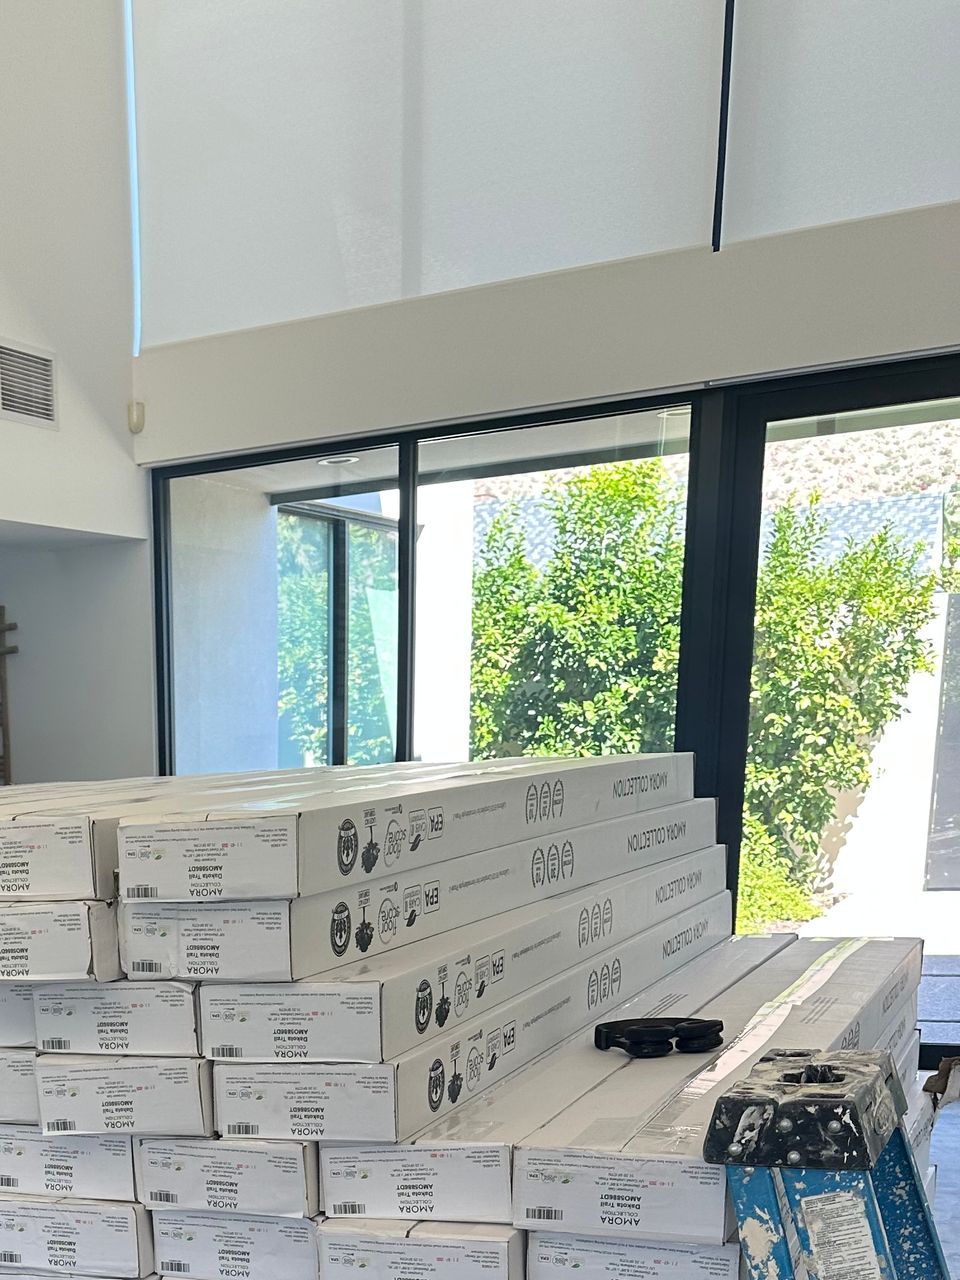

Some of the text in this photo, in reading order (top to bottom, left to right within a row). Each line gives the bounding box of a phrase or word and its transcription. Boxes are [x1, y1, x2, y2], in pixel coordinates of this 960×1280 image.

[613, 776, 648, 799] COLLECTION
[430, 814, 443, 832] EPA
[389, 830, 407, 846] score
[628, 821, 686, 853] AMORA COLLECTION
[386, 844, 401, 860] floor
[0, 882, 30, 892] AMORA
[189, 887, 223, 897] AMORA
[656, 877, 686, 905] COLLECTION
[424, 888, 438, 906] EPA
[381, 906, 400, 922] score
[381, 919, 396, 936] floor
[663, 928, 692, 960] COLLECTION
[0, 968, 29, 977] AMORA
[187, 966, 220, 975] AMORA
[492, 957, 504, 976] EPA
[456, 979, 472, 995] score
[456, 993, 470, 1008] floor
[503, 1028, 514, 1048] EPA
[274, 1050, 308, 1058] AMORA
[469, 1052, 484, 1070] score
[468, 1067, 480, 1082] floor
[104, 1120, 135, 1129] AMORA
[290, 1128, 325, 1136] AMORA
[398, 1204, 434, 1213] AMORA
[616, 1202, 641, 1210] Dakota
[600, 1216, 640, 1226] AMORA
[48, 1258, 77, 1267] AMORA
[219, 1268, 250, 1277] AMORA
